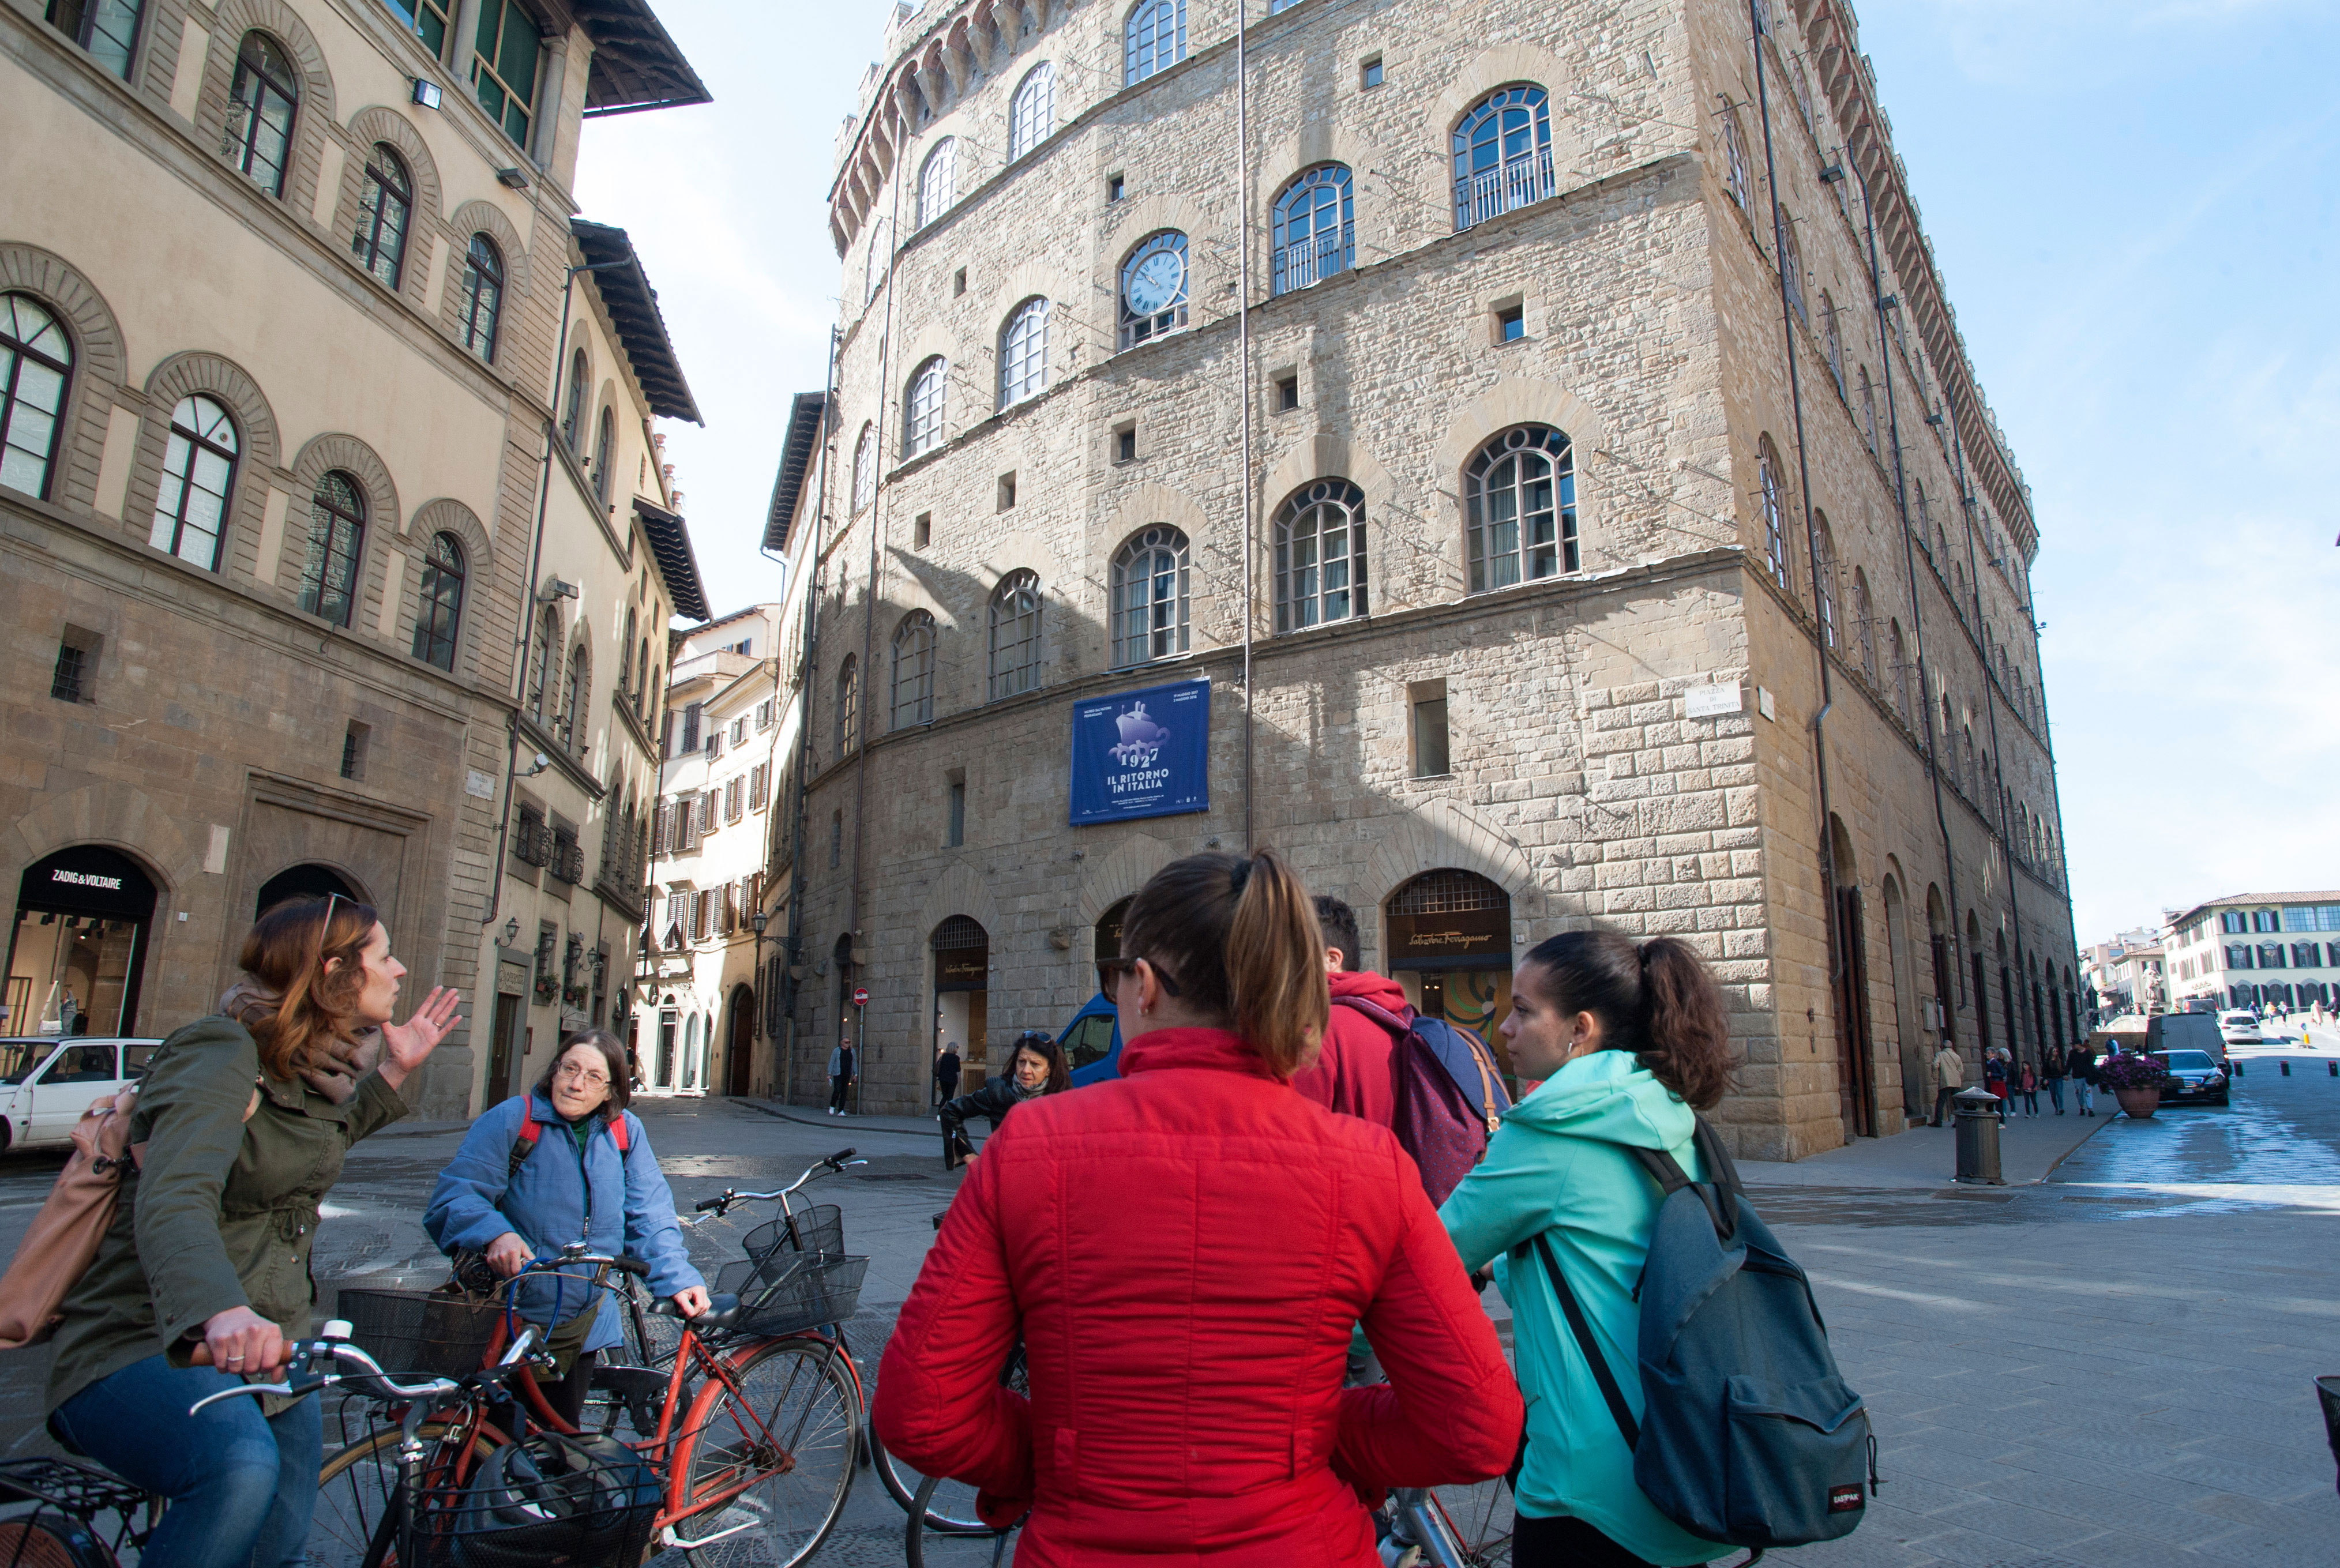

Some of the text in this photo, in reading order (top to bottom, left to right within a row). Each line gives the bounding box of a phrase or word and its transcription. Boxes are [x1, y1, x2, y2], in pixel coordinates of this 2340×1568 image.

[1699, 687, 1725, 696] PIAZZA
[1688, 701, 1740, 714] SANTA TRINITA
[1121, 748, 1159, 768] 1927
[1107, 768, 1169, 785] IL RITORNO
[1113, 779, 1163, 793] IN ITALIA
[1408, 931, 1492, 949] Salvatore Ferragamo
[1833, 1493, 1859, 1503] EASTPAK
